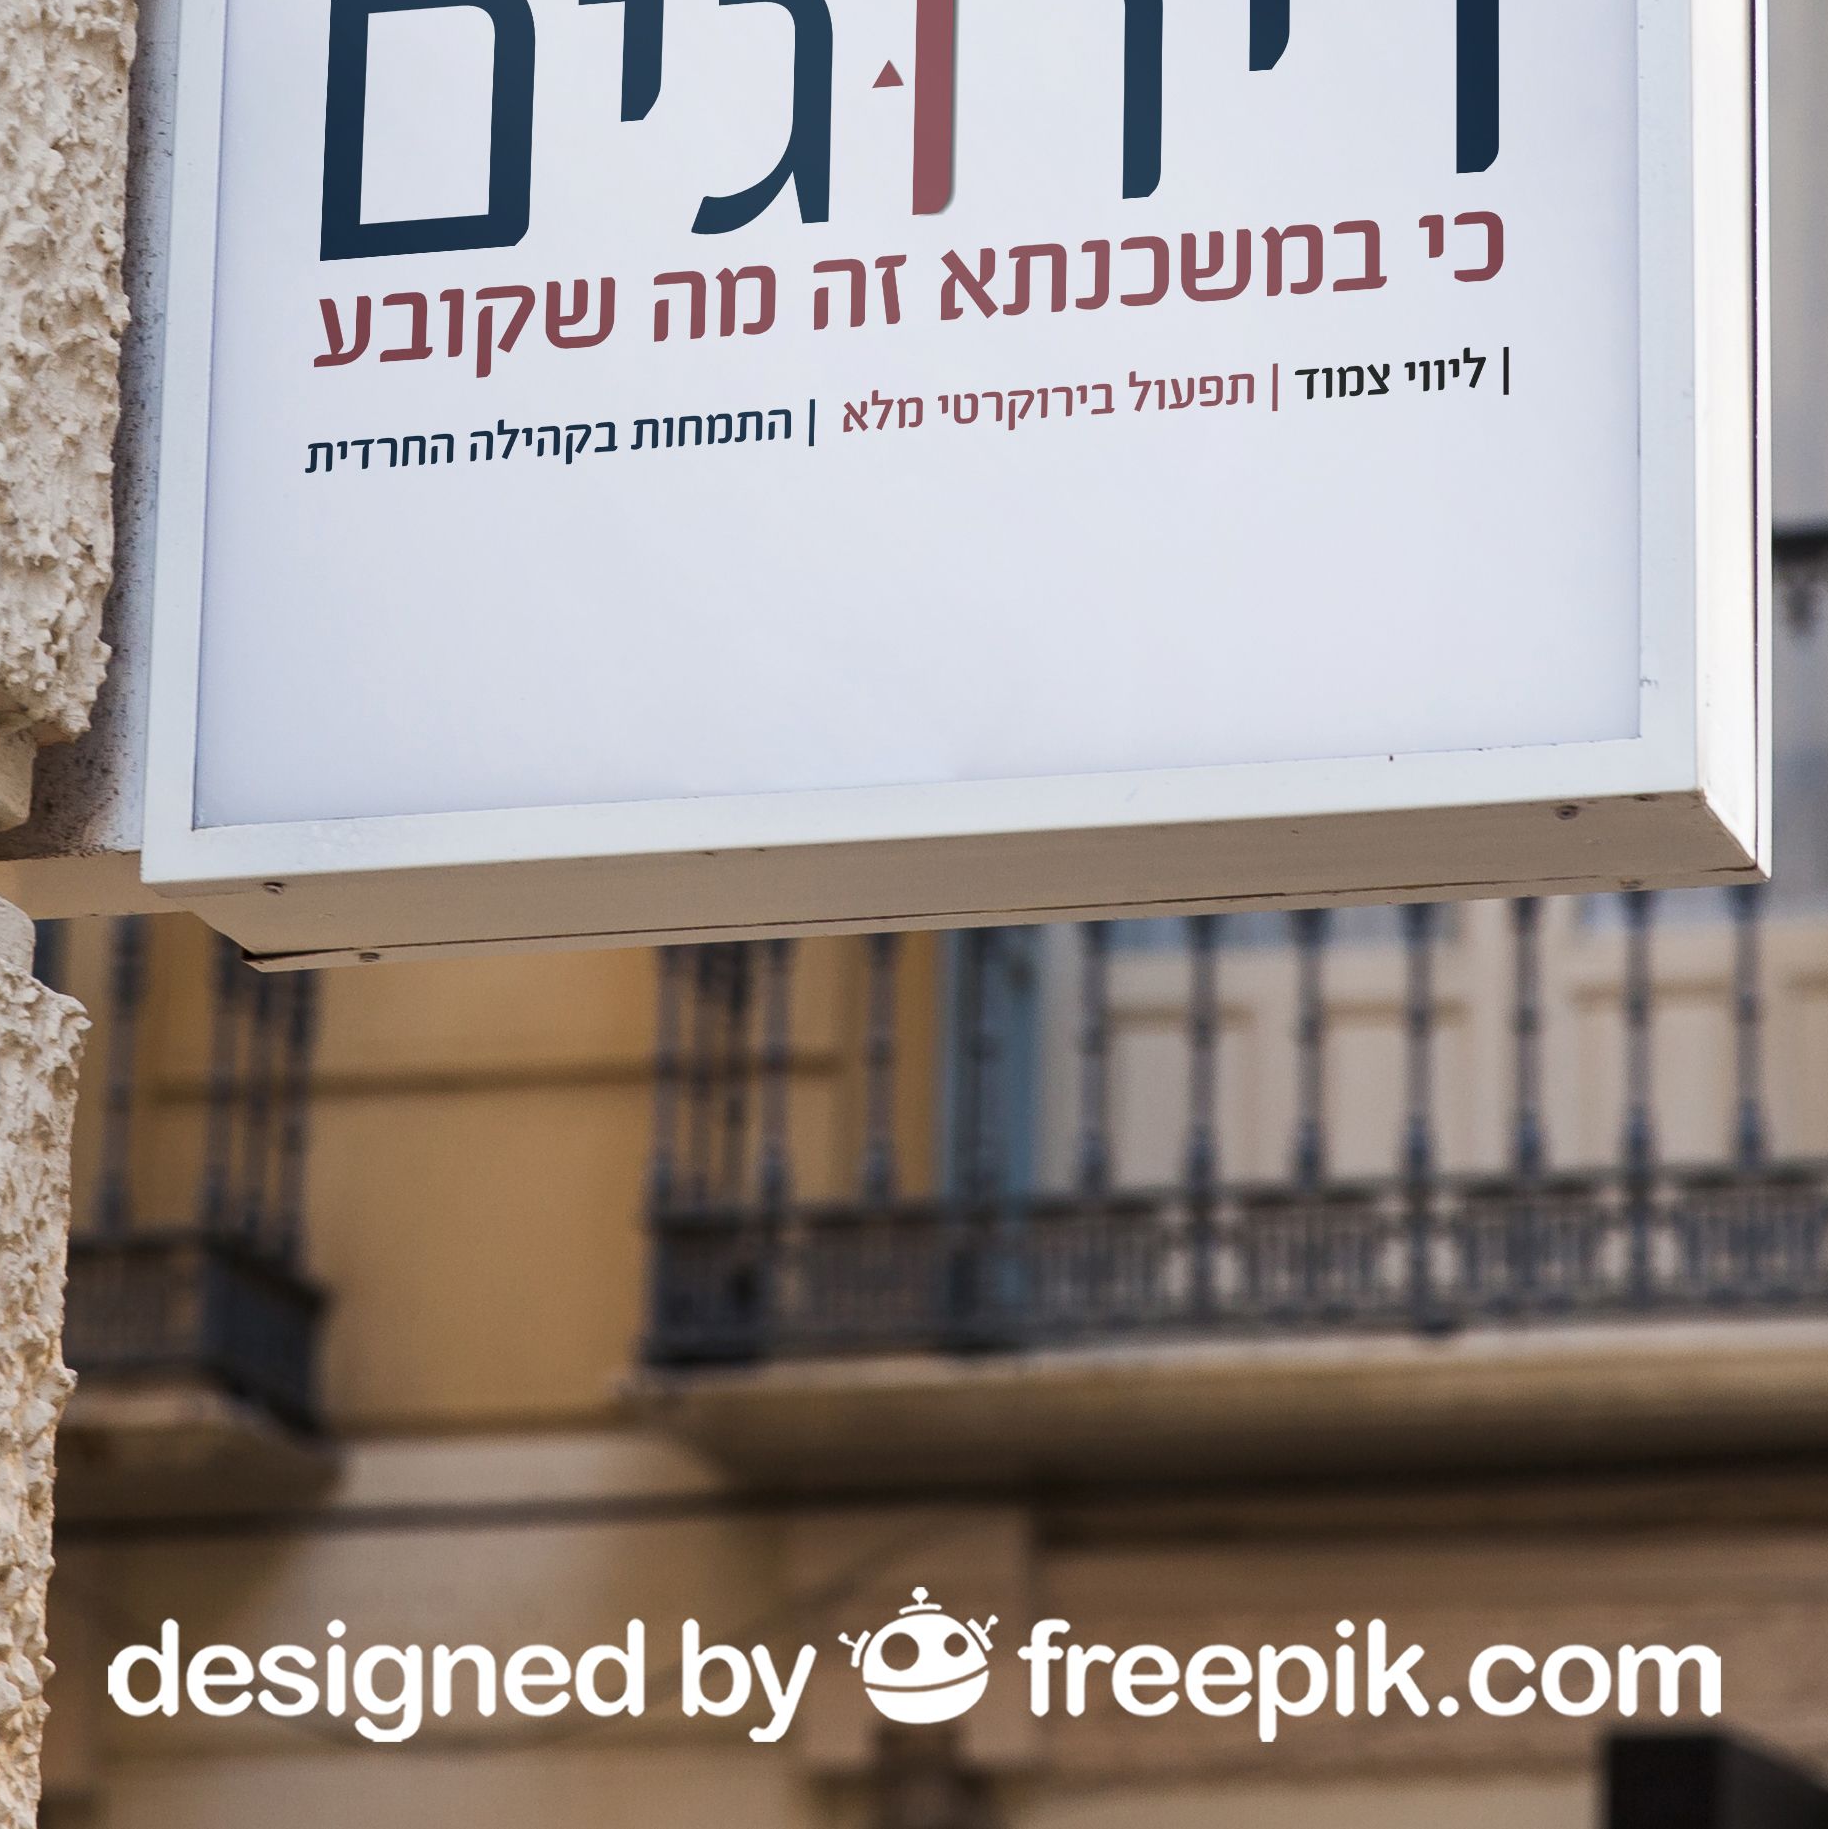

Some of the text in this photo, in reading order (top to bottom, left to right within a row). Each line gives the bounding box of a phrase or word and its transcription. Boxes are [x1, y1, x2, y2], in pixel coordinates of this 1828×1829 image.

[313, 210, 1504, 379] כי במשכנתא זה מה שקובע
[304, 346, 1487, 474] ליווי צמוד תפעול בירוקרטי מלא התמחות בקהילה החרדית
